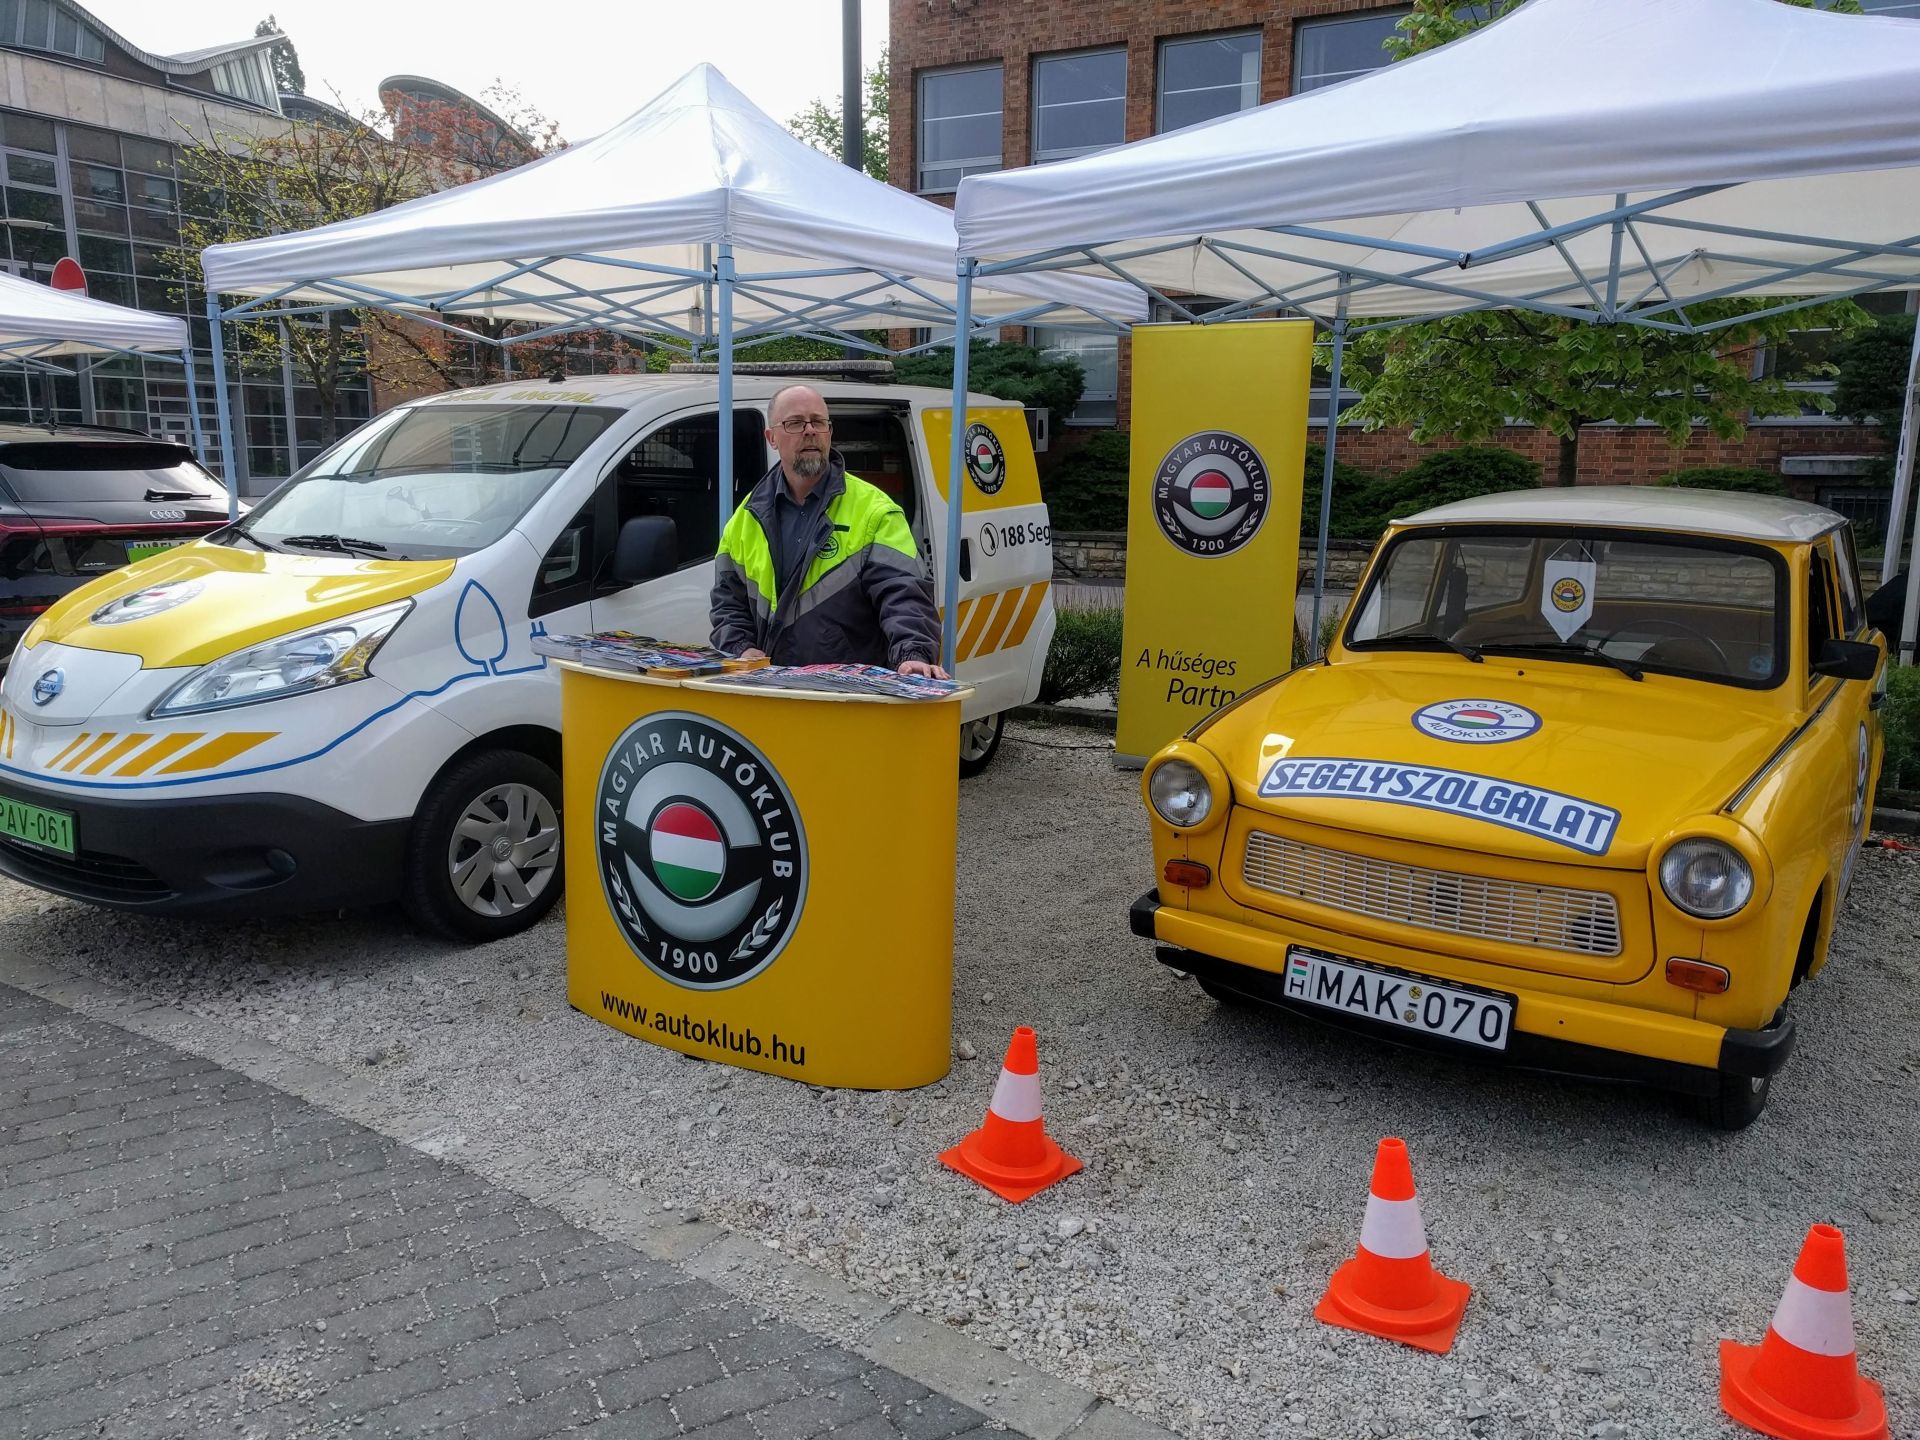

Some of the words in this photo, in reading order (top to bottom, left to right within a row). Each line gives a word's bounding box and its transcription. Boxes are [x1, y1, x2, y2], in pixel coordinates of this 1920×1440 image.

[1159, 442, 1202, 499] MAGYAR
[1208, 439, 1264, 502] AUTÓKLUB
[1000, 525, 1026, 548] 188
[1192, 538, 1225, 551] 1900
[1136, 648, 1151, 668] A
[1156, 649, 1237, 679] hűséges
[1443, 703, 1523, 719] MAGYAR
[1427, 721, 1507, 739] AUTÓKLUB
[604, 732, 665, 846] MAGYAR
[677, 730, 793, 879] AUTÓKLUB
[1266, 762, 1612, 845] SEGÉLYSZOLGÁLAT
[658, 941, 718, 974] 1900
[1289, 977, 1305, 995] H
[601, 990, 806, 1066] www.autoklub.hu
